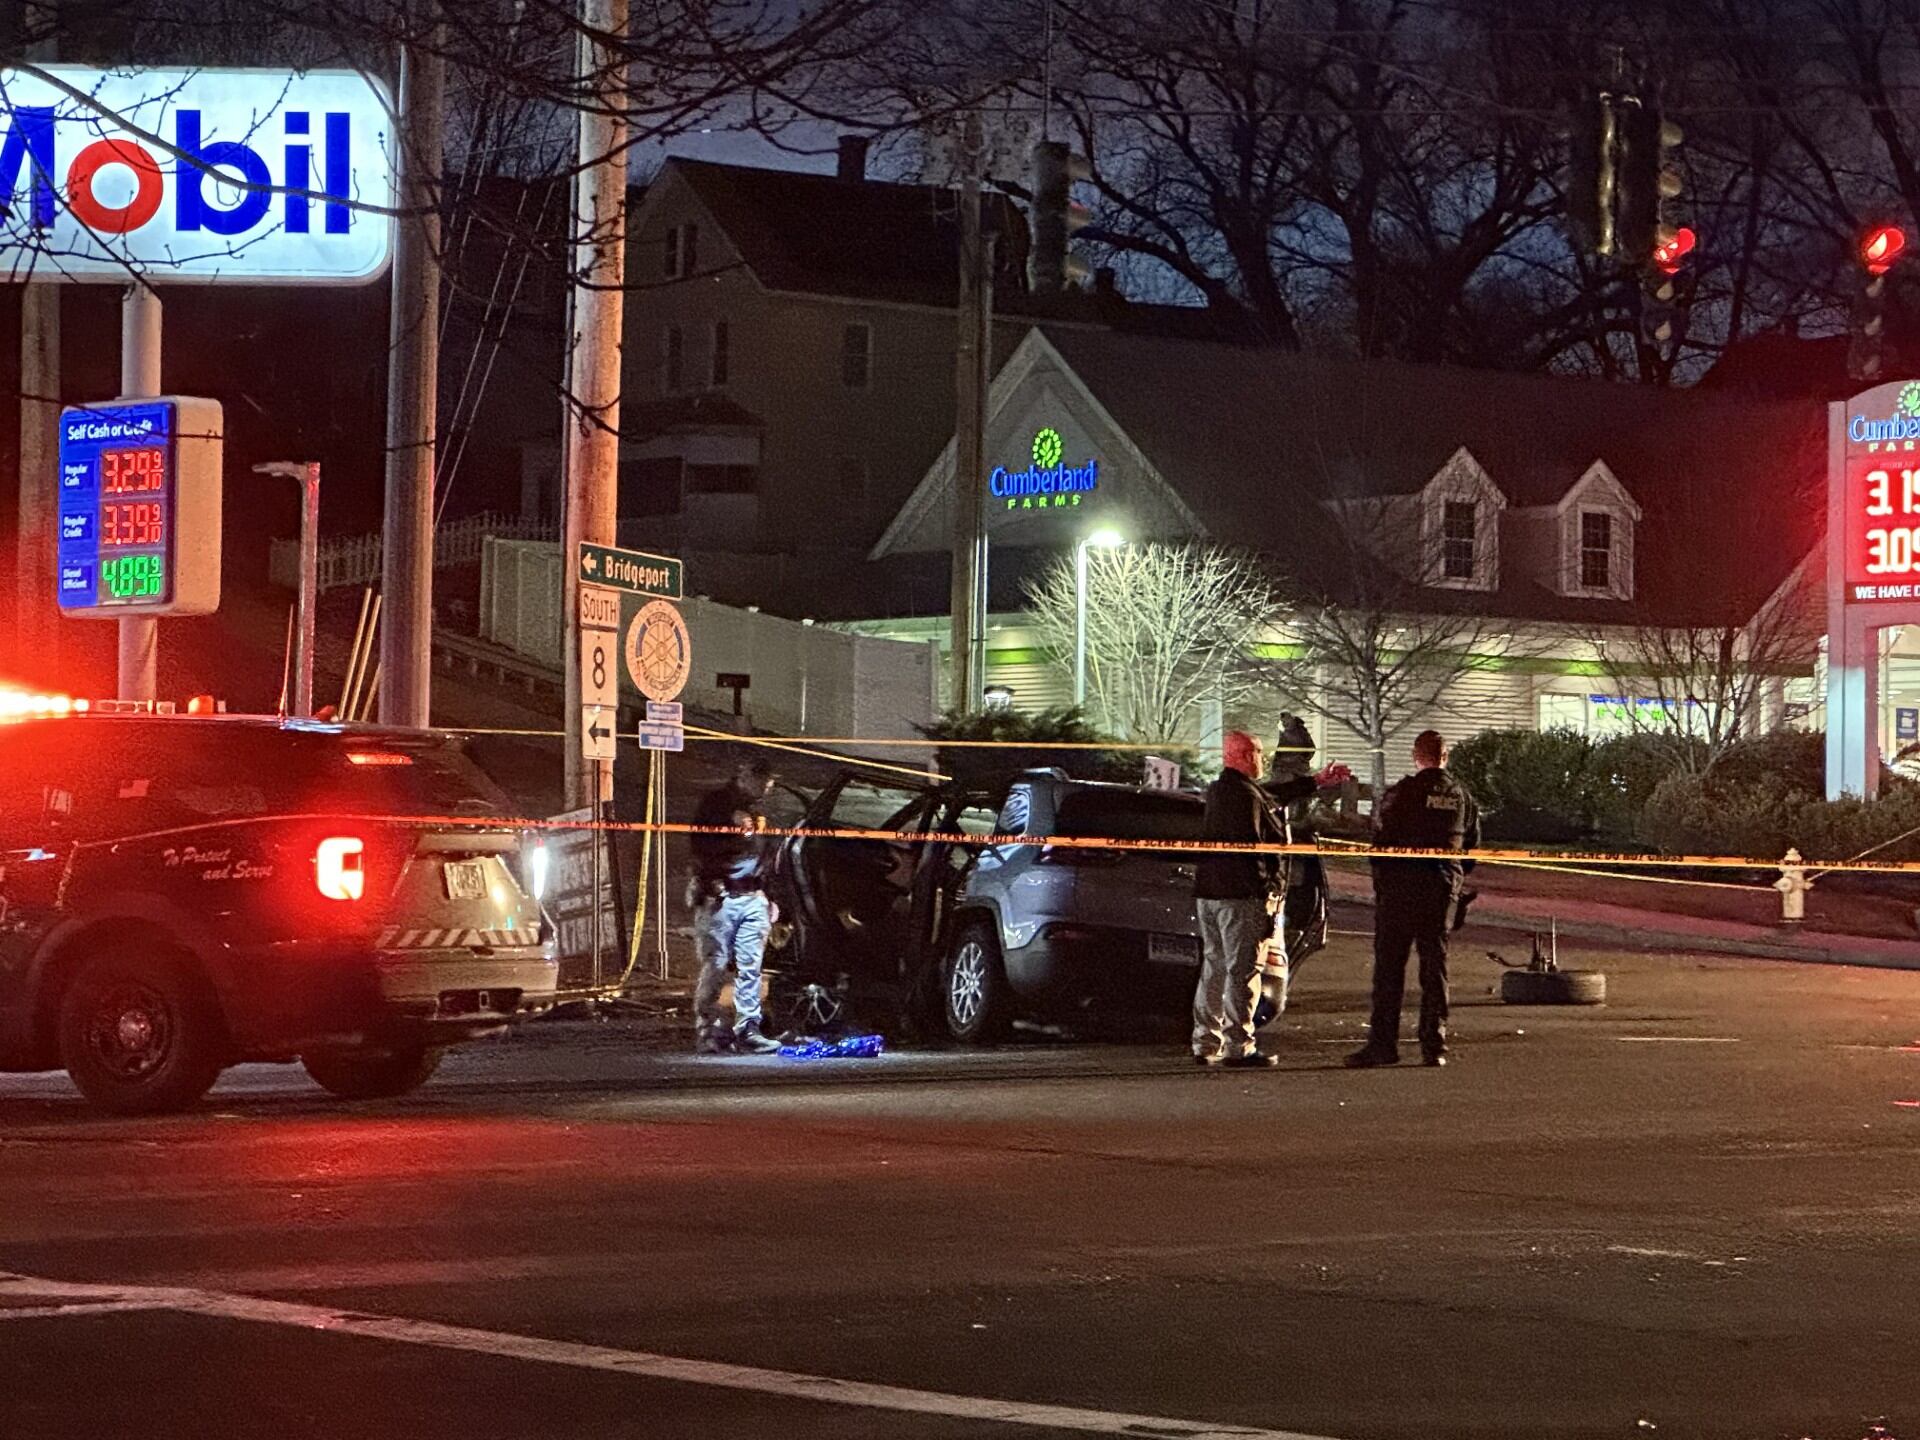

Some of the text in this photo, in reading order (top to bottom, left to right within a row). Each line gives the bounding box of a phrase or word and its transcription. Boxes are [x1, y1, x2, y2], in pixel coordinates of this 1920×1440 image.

[68, 423, 87, 440] Self
[87, 422, 110, 439] Cash
[111, 425, 122, 437] or
[1848, 412, 1920, 442] Cumbe
[990, 459, 1097, 497] Cumberland
[1007, 494, 1081, 510] FARMS
[605, 555, 670, 589] Bridgeport
[1855, 585, 1877, 599] WE
[1878, 584, 1912, 598] HAVE
[583, 593, 617, 621] SOUTH
[592, 646, 606, 689] 8
